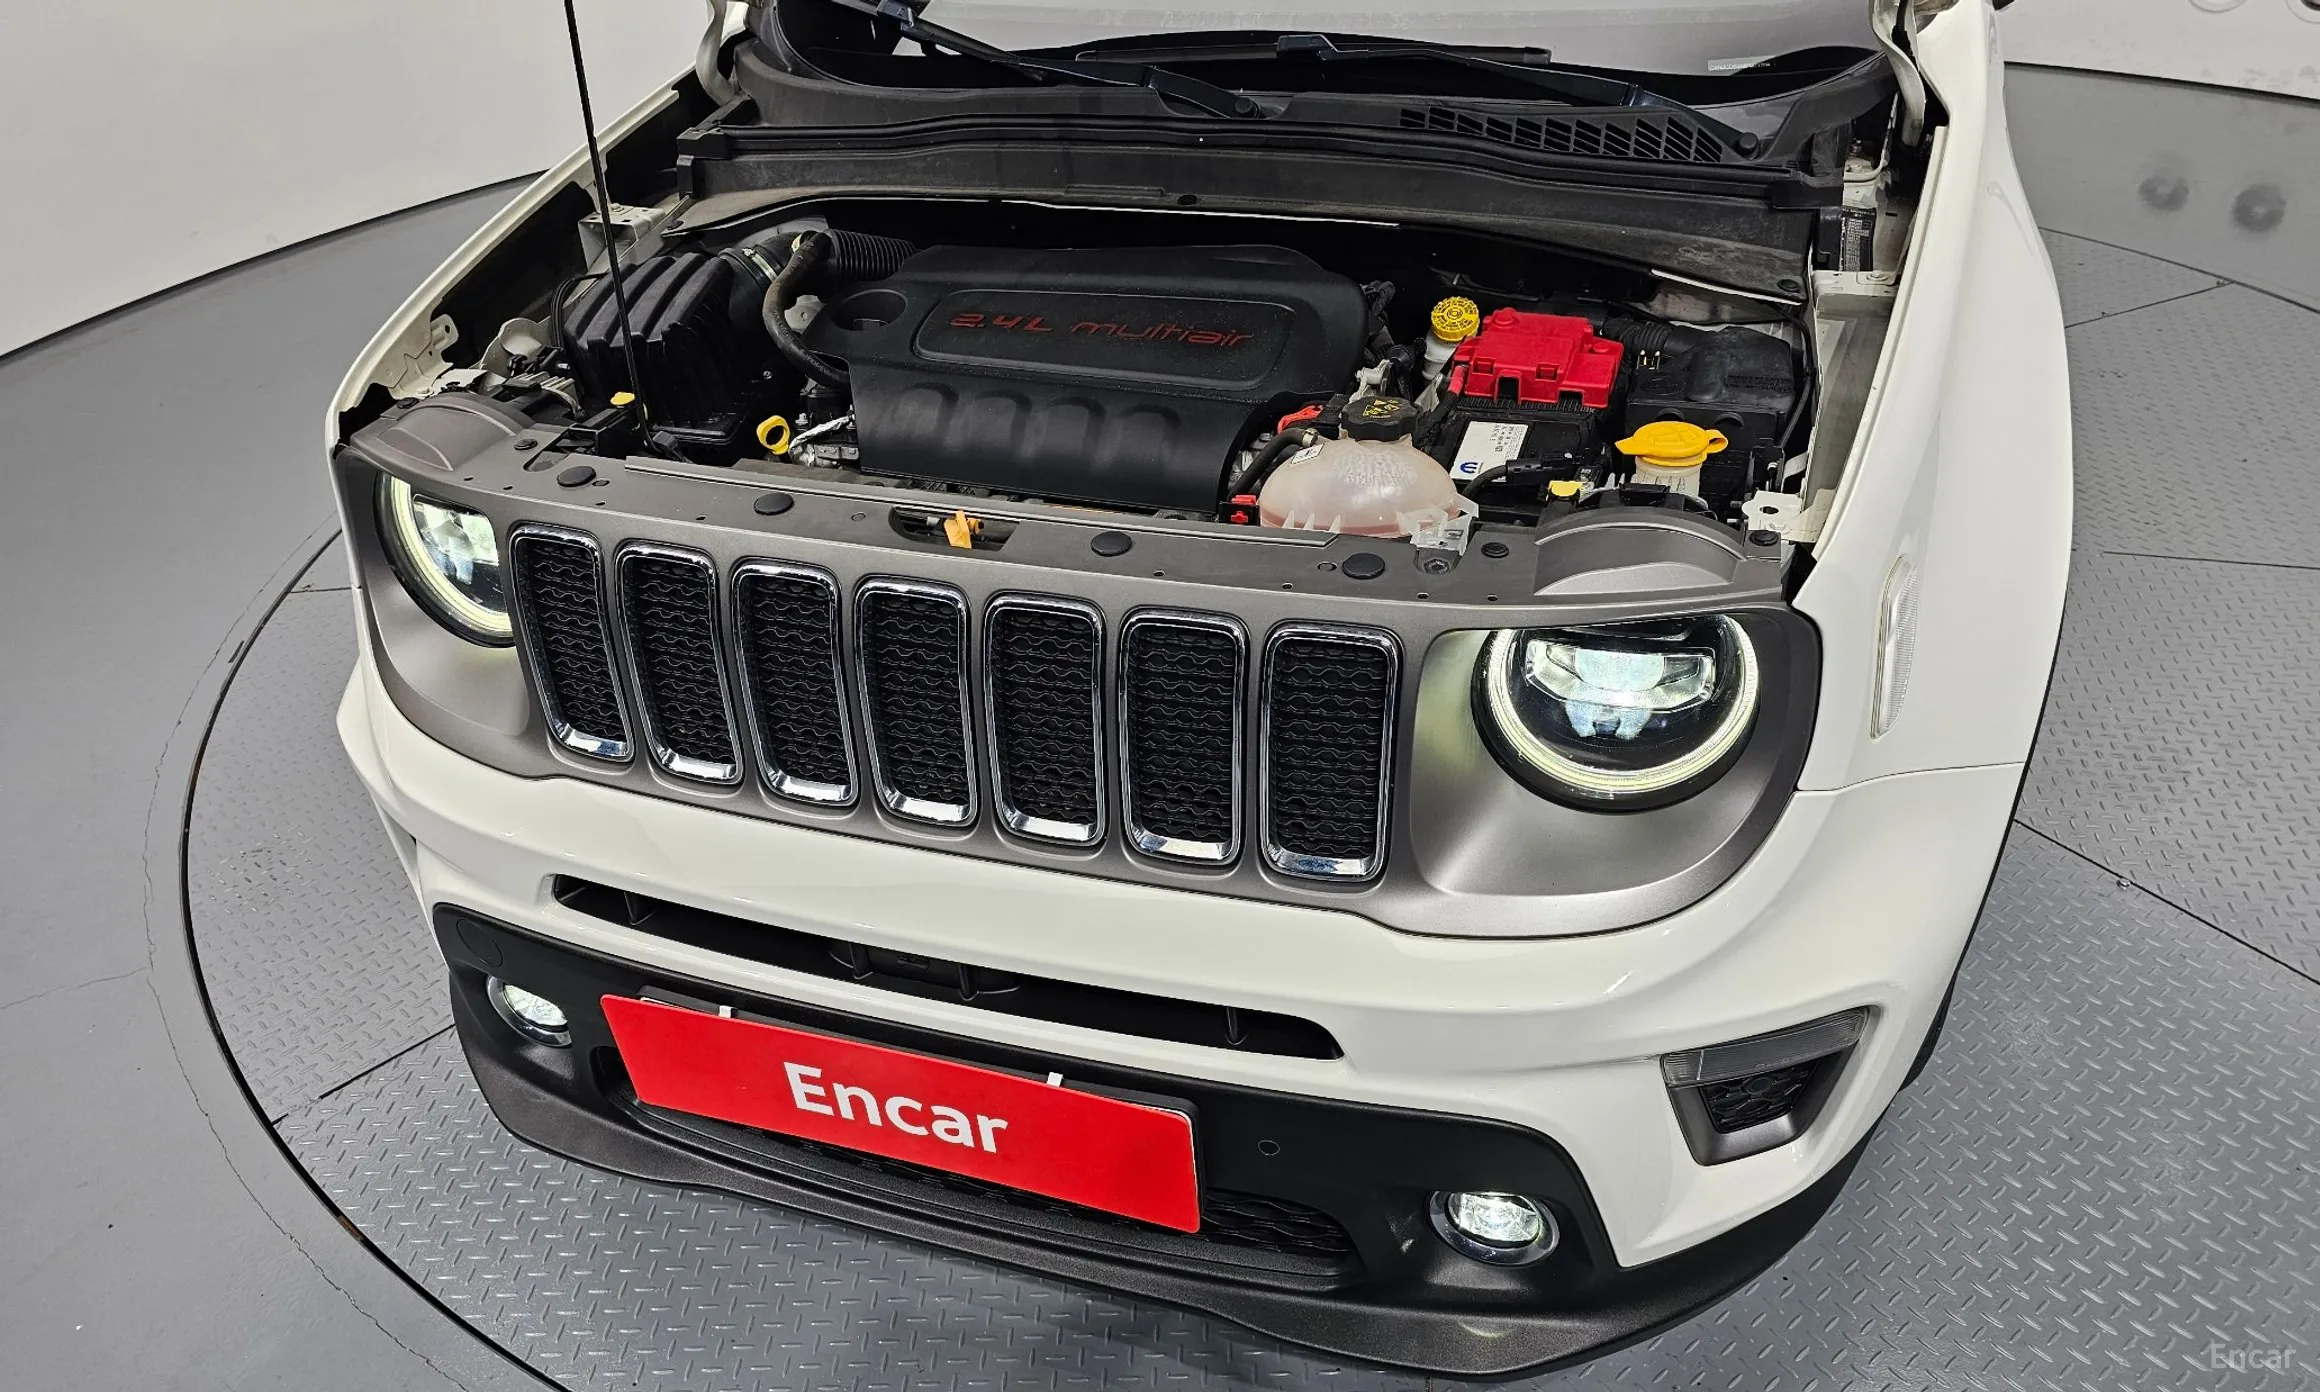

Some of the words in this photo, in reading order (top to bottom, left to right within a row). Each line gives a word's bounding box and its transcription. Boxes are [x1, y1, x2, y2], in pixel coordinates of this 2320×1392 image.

[950, 313, 1054, 332] 2.4L
[1070, 321, 1253, 346] multiair
[783, 1061, 1008, 1154] Encar
